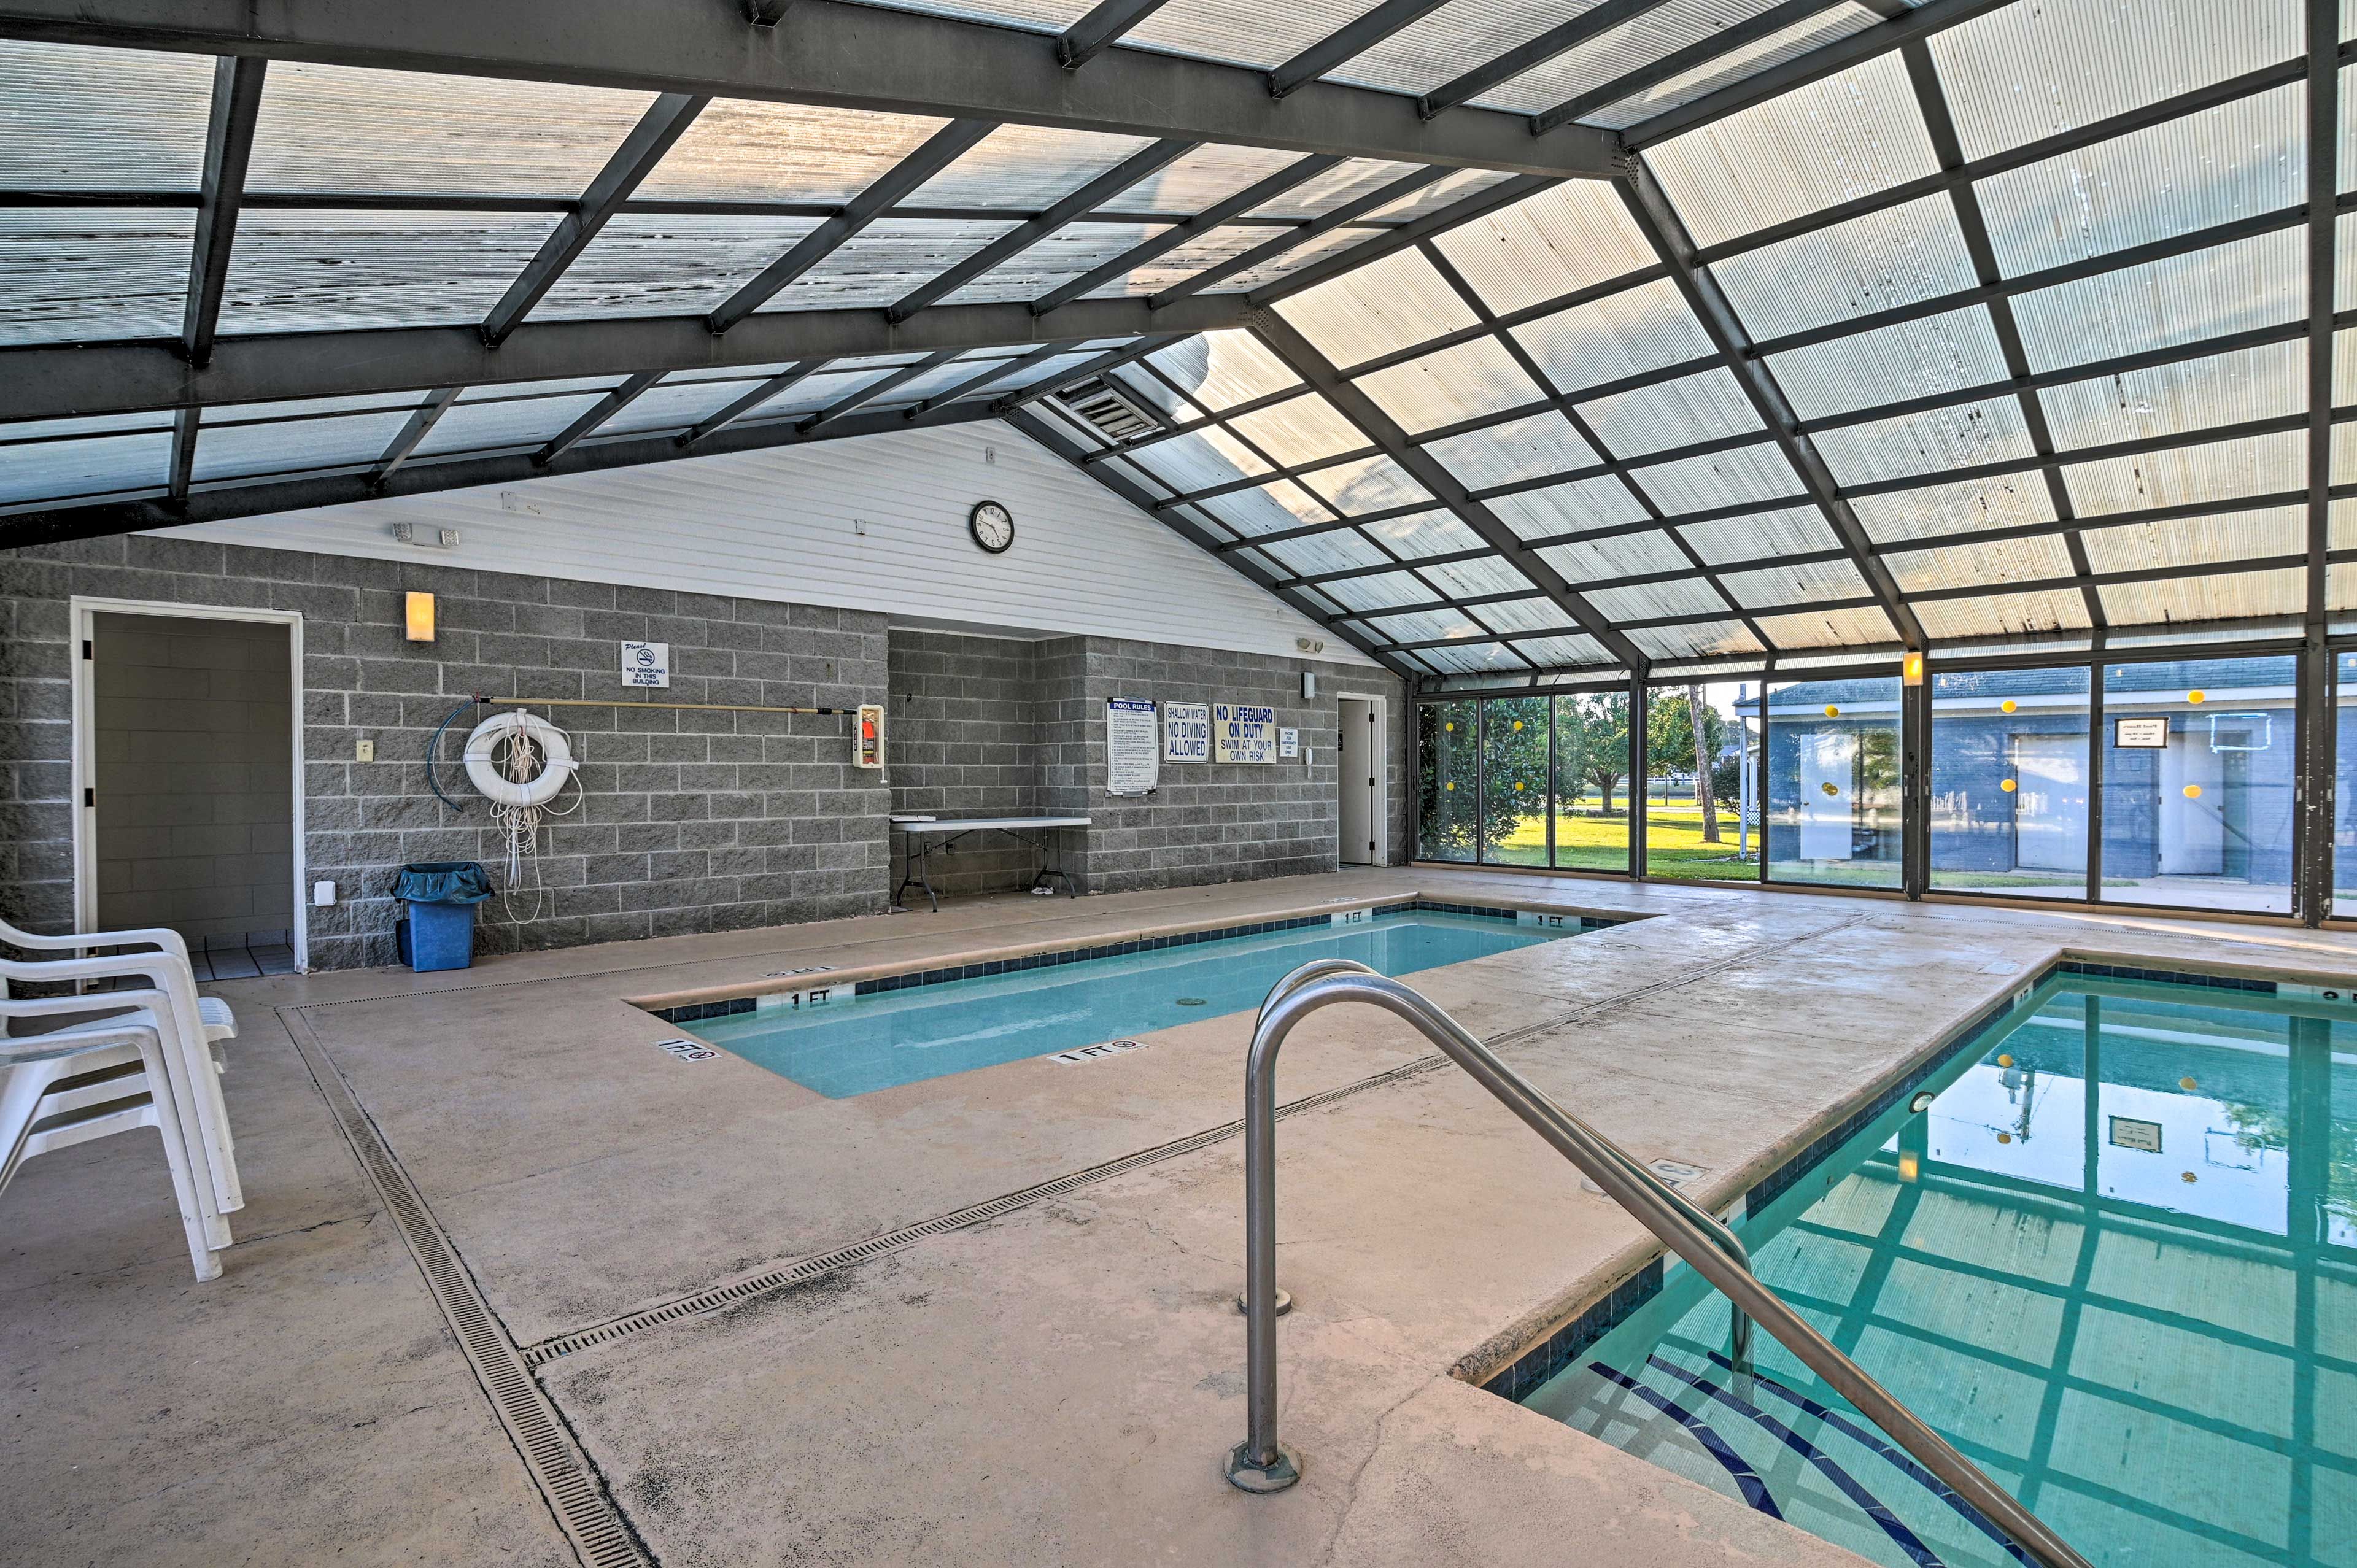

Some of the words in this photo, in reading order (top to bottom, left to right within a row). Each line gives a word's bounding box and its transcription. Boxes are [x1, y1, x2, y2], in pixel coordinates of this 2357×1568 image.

[1168, 708, 1190, 719] SHALLOW
[1191, 709, 1206, 720] WATER
[1217, 705, 1228, 721] NO
[1232, 706, 1273, 723] LIFEGUARD
[1168, 721, 1179, 738] NO
[1182, 722, 1206, 738] DIVING
[1229, 722, 1240, 738] ON
[1244, 723, 1263, 738] DUTY
[1169, 740, 1206, 757] ALLOWED
[1221, 739, 1239, 750] SWIM
[1242, 740, 1251, 750] AT
[1253, 740, 1272, 751] YOUR
[1229, 751, 1246, 761] OWN
[1249, 751, 1264, 762] RISK
[791, 993, 799, 1005] 1
[810, 989, 830, 1003] FT
[667, 1044, 702, 1053] FT
[1078, 1046, 1113, 1057] FT
